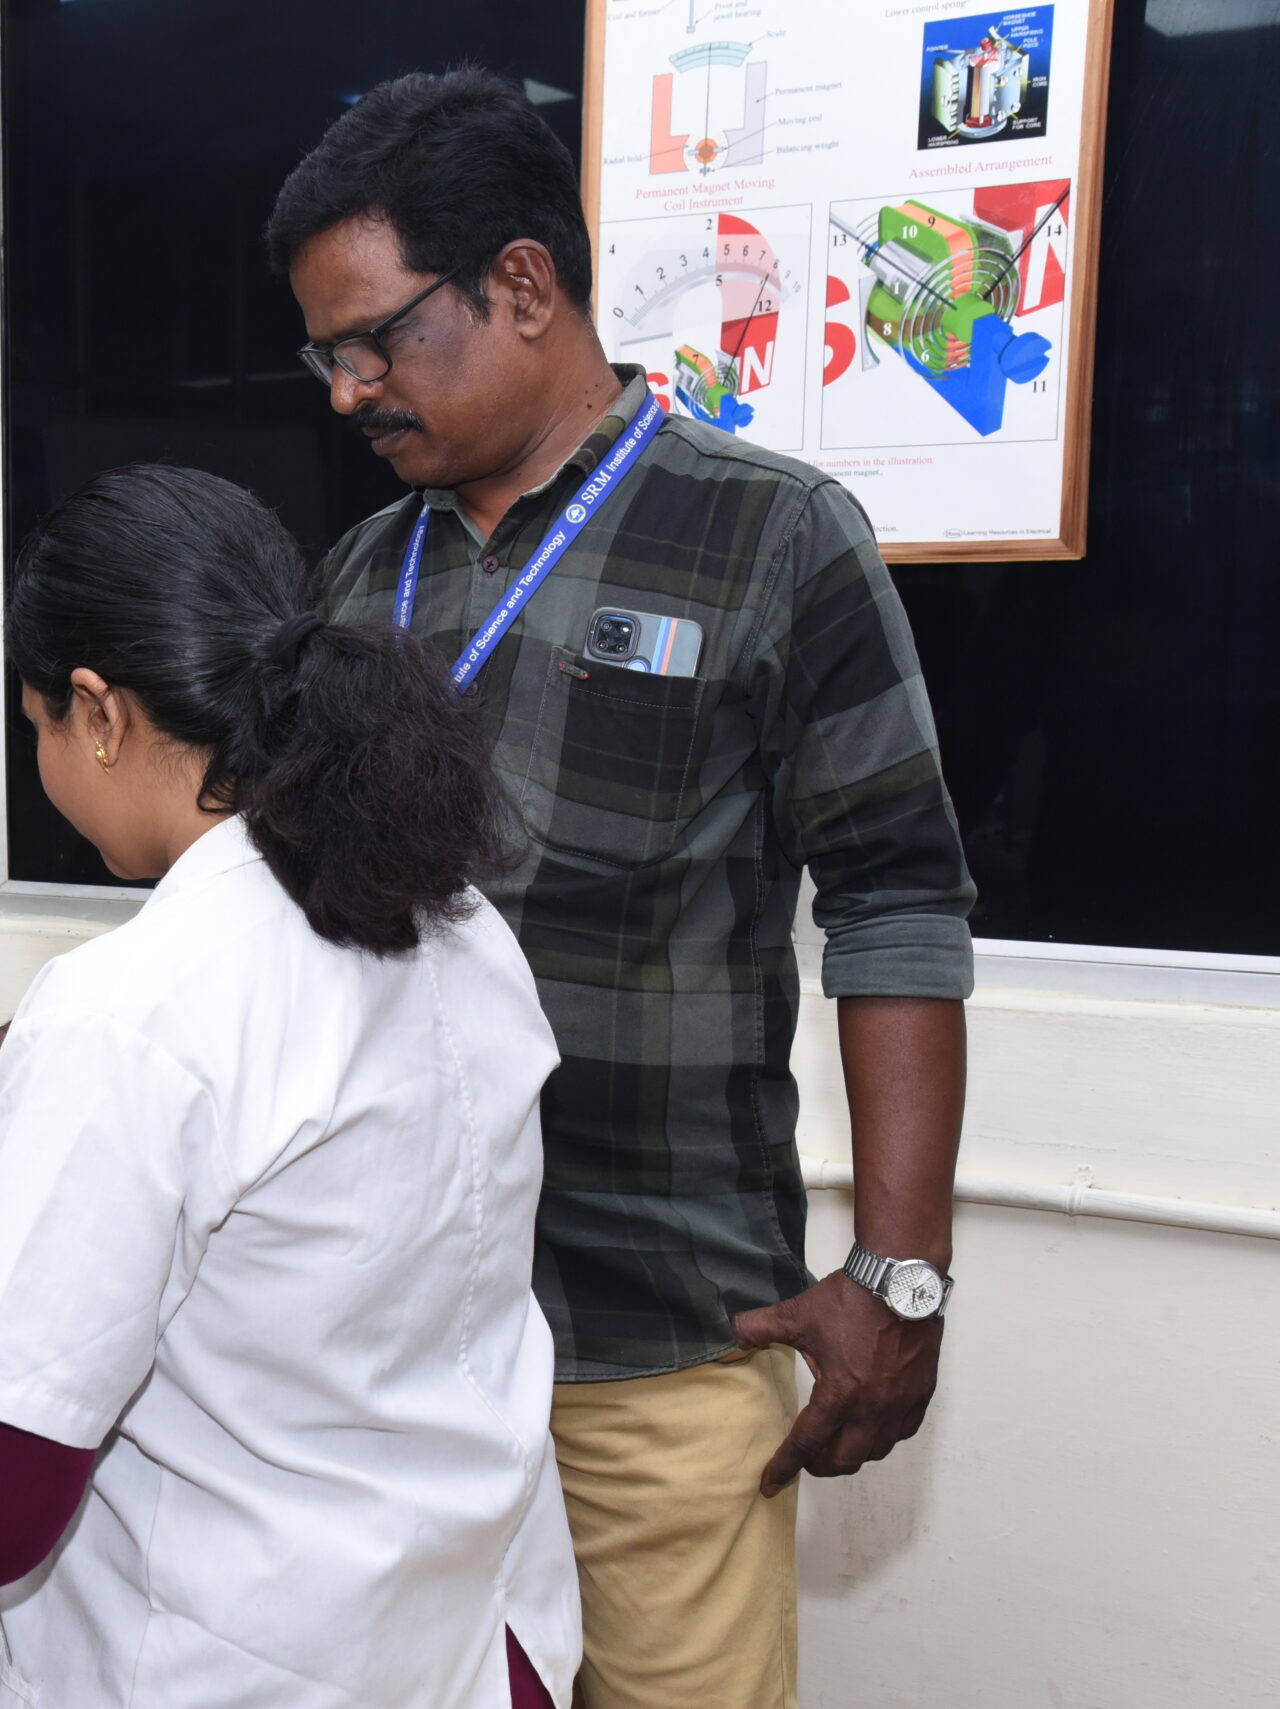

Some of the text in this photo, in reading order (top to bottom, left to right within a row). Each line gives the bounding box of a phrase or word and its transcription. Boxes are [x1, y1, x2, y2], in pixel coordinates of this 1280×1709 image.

[884, 0, 966, 18] Lower control spring
[766, 30, 786, 38] Scale
[775, 81, 842, 95] Permanent magnet
[778, 113, 822, 125] Moving coil
[776, 139, 839, 153] Balancing weight
[909, 154, 1053, 179] Assembled Arrangement
[635, 177, 775, 200] Permanent Magnet Moving
[663, 195, 745, 211] Coil Instrument
[705, 219, 713, 230] 2
[927, 216, 936, 229] 9
[902, 225, 918, 239] 10
[1046, 224, 1062, 237] 14
[832, 234, 847, 247] 13
[608, 243, 615, 255] 4
[702, 246, 710, 258] 4
[723, 244, 730, 256] 5
[742, 245, 750, 257] 6
[759, 250, 766, 261] 7
[679, 254, 688, 267] 3
[656, 267, 667, 280] 2
[715, 275, 723, 287] 5
[893, 281, 900, 294] 1
[634, 284, 645, 296] 1
[757, 299, 772, 312] 12
[883, 322, 893, 336] 8
[920, 350, 930, 362] 6
[740, 341, 775, 395] N
[1032, 380, 1047, 393] 11
[581, 470, 612, 505] SRM
[605, 437, 637, 472] Institute
[633, 427, 644, 439] of
[826, 459, 860, 468] numbers
[873, 458, 885, 466] the
[964, 529, 987, 537] Learning
[1026, 527, 1052, 535] Electrical
[403, 579, 412, 598] and
[469, 530, 566, 662] of Science and Technology
